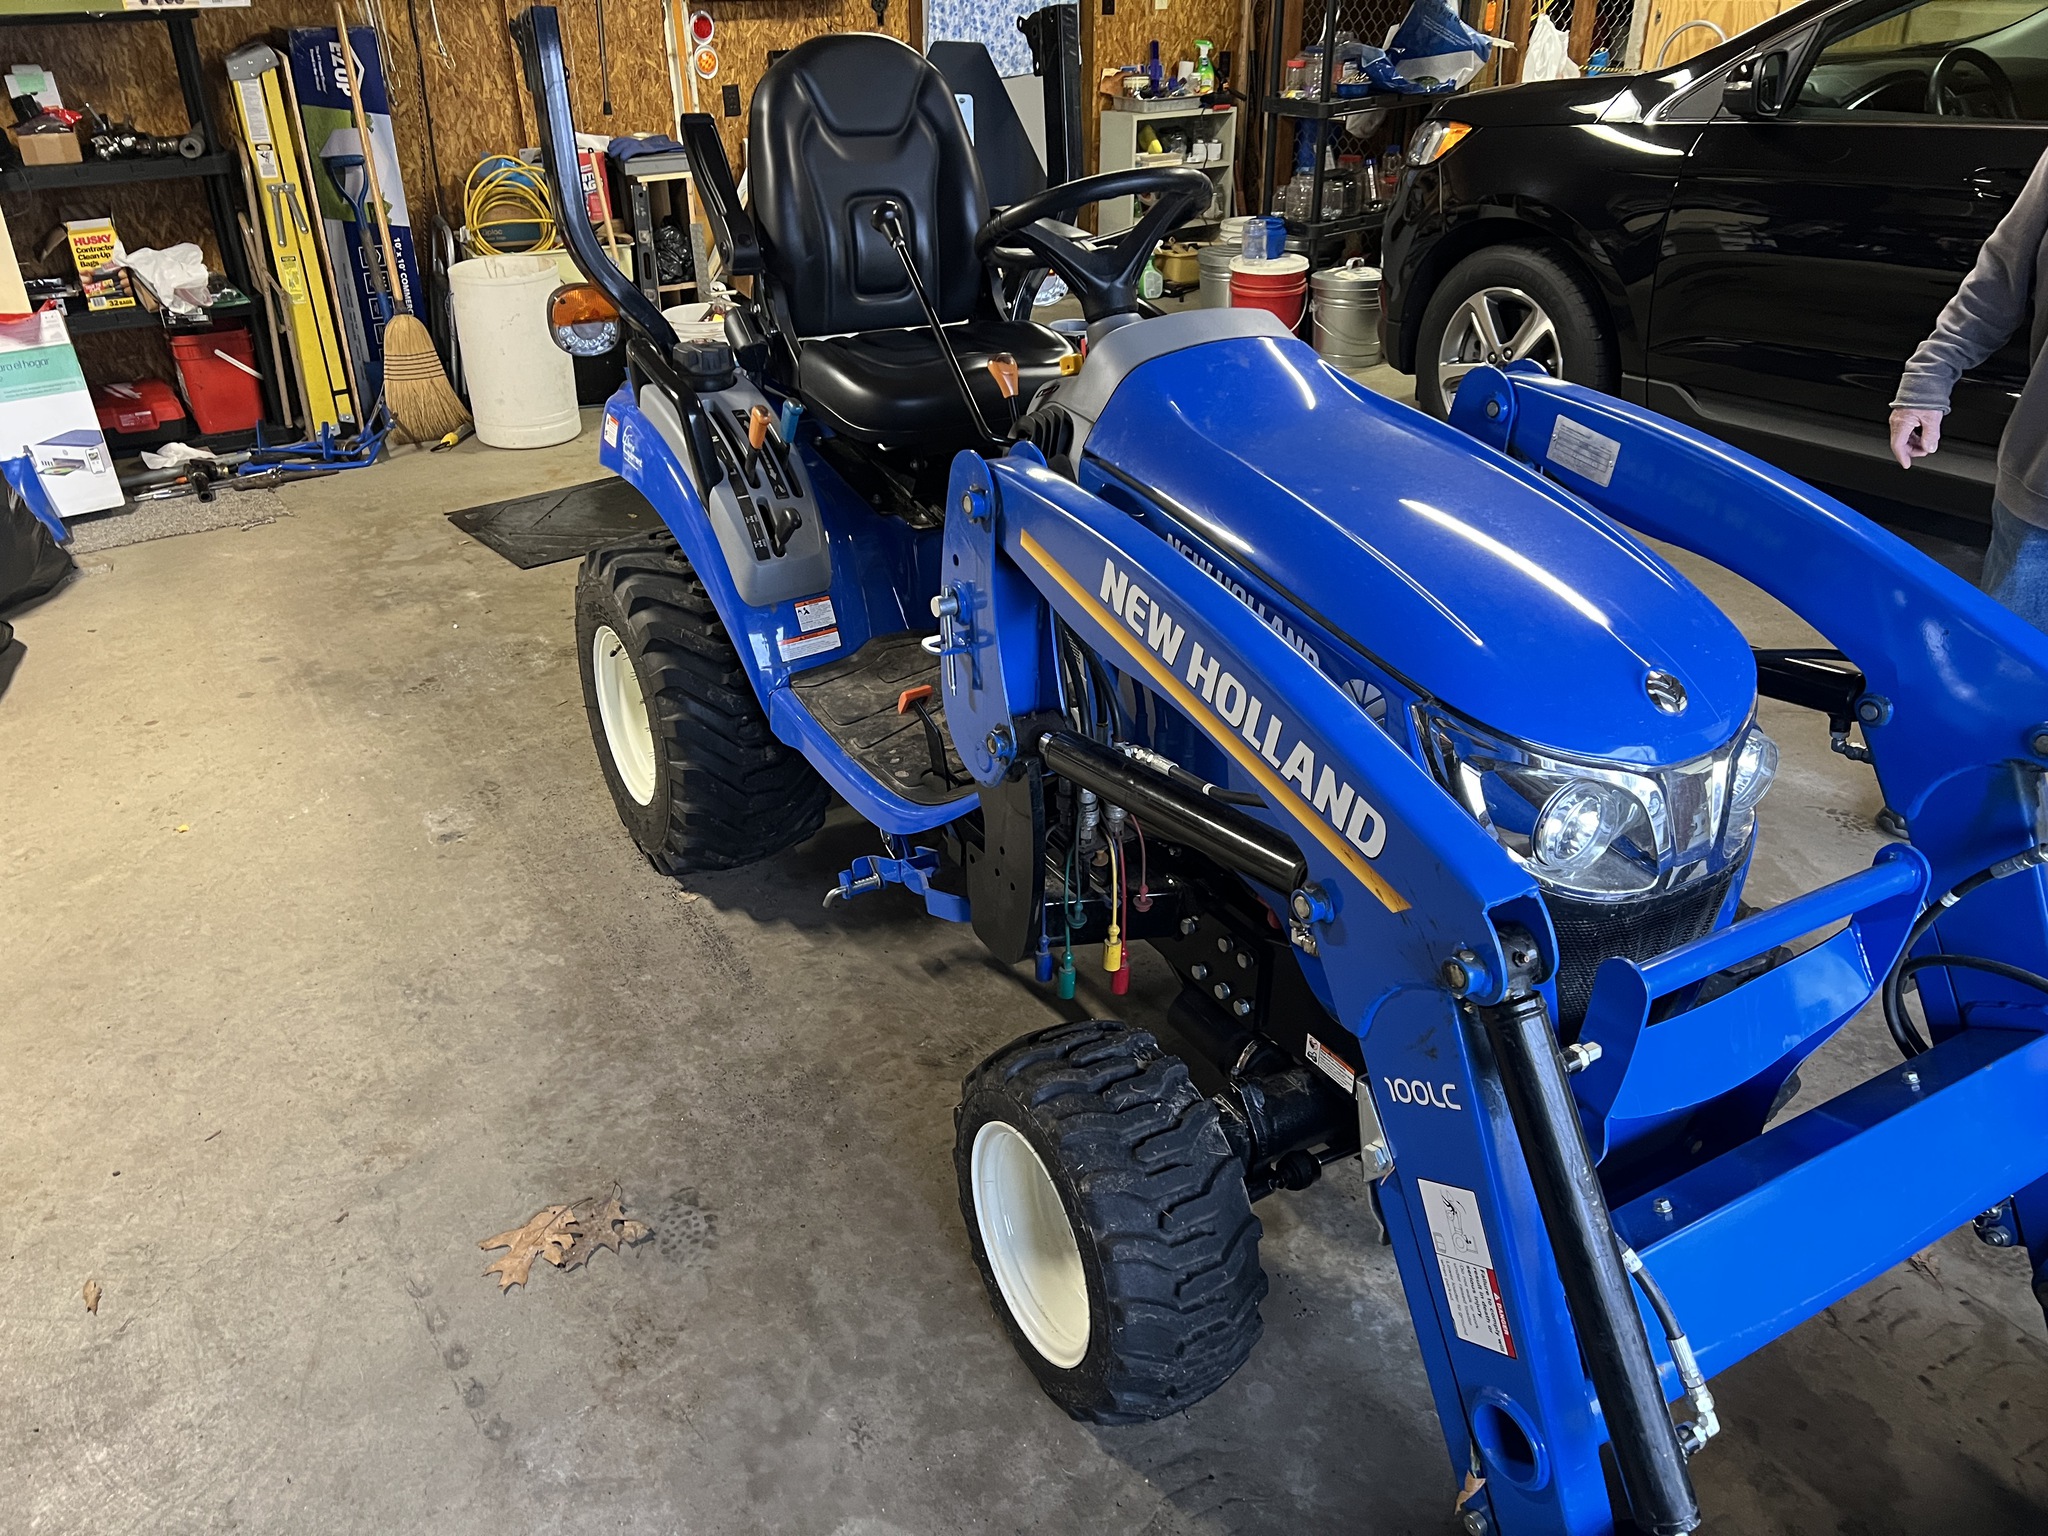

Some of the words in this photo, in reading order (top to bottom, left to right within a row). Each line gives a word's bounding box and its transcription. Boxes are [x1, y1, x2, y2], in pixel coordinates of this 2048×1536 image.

[73, 234, 111, 246] HUSKY
[393, 237, 403, 250] 10'
[397, 258, 407, 271] 10'
[22, 358, 50, 370] hogar
[1099, 557, 1186, 666] NEW
[1185, 641, 1387, 860] HOLLAND
[1384, 1076, 1462, 1111] 100LC
[1466, 1265, 1477, 1294] serious
[1473, 1295, 1483, 1319] injury
[1479, 1269, 1490, 1296] Failure
[1473, 1267, 1482, 1290] result
[1482, 1301, 1491, 1324] death
[1488, 1325, 1493, 1334] or
[1487, 1298, 1493, 1306] to
[1489, 1308, 1501, 1337] comply
[1496, 1302, 1509, 1336] DANGER
